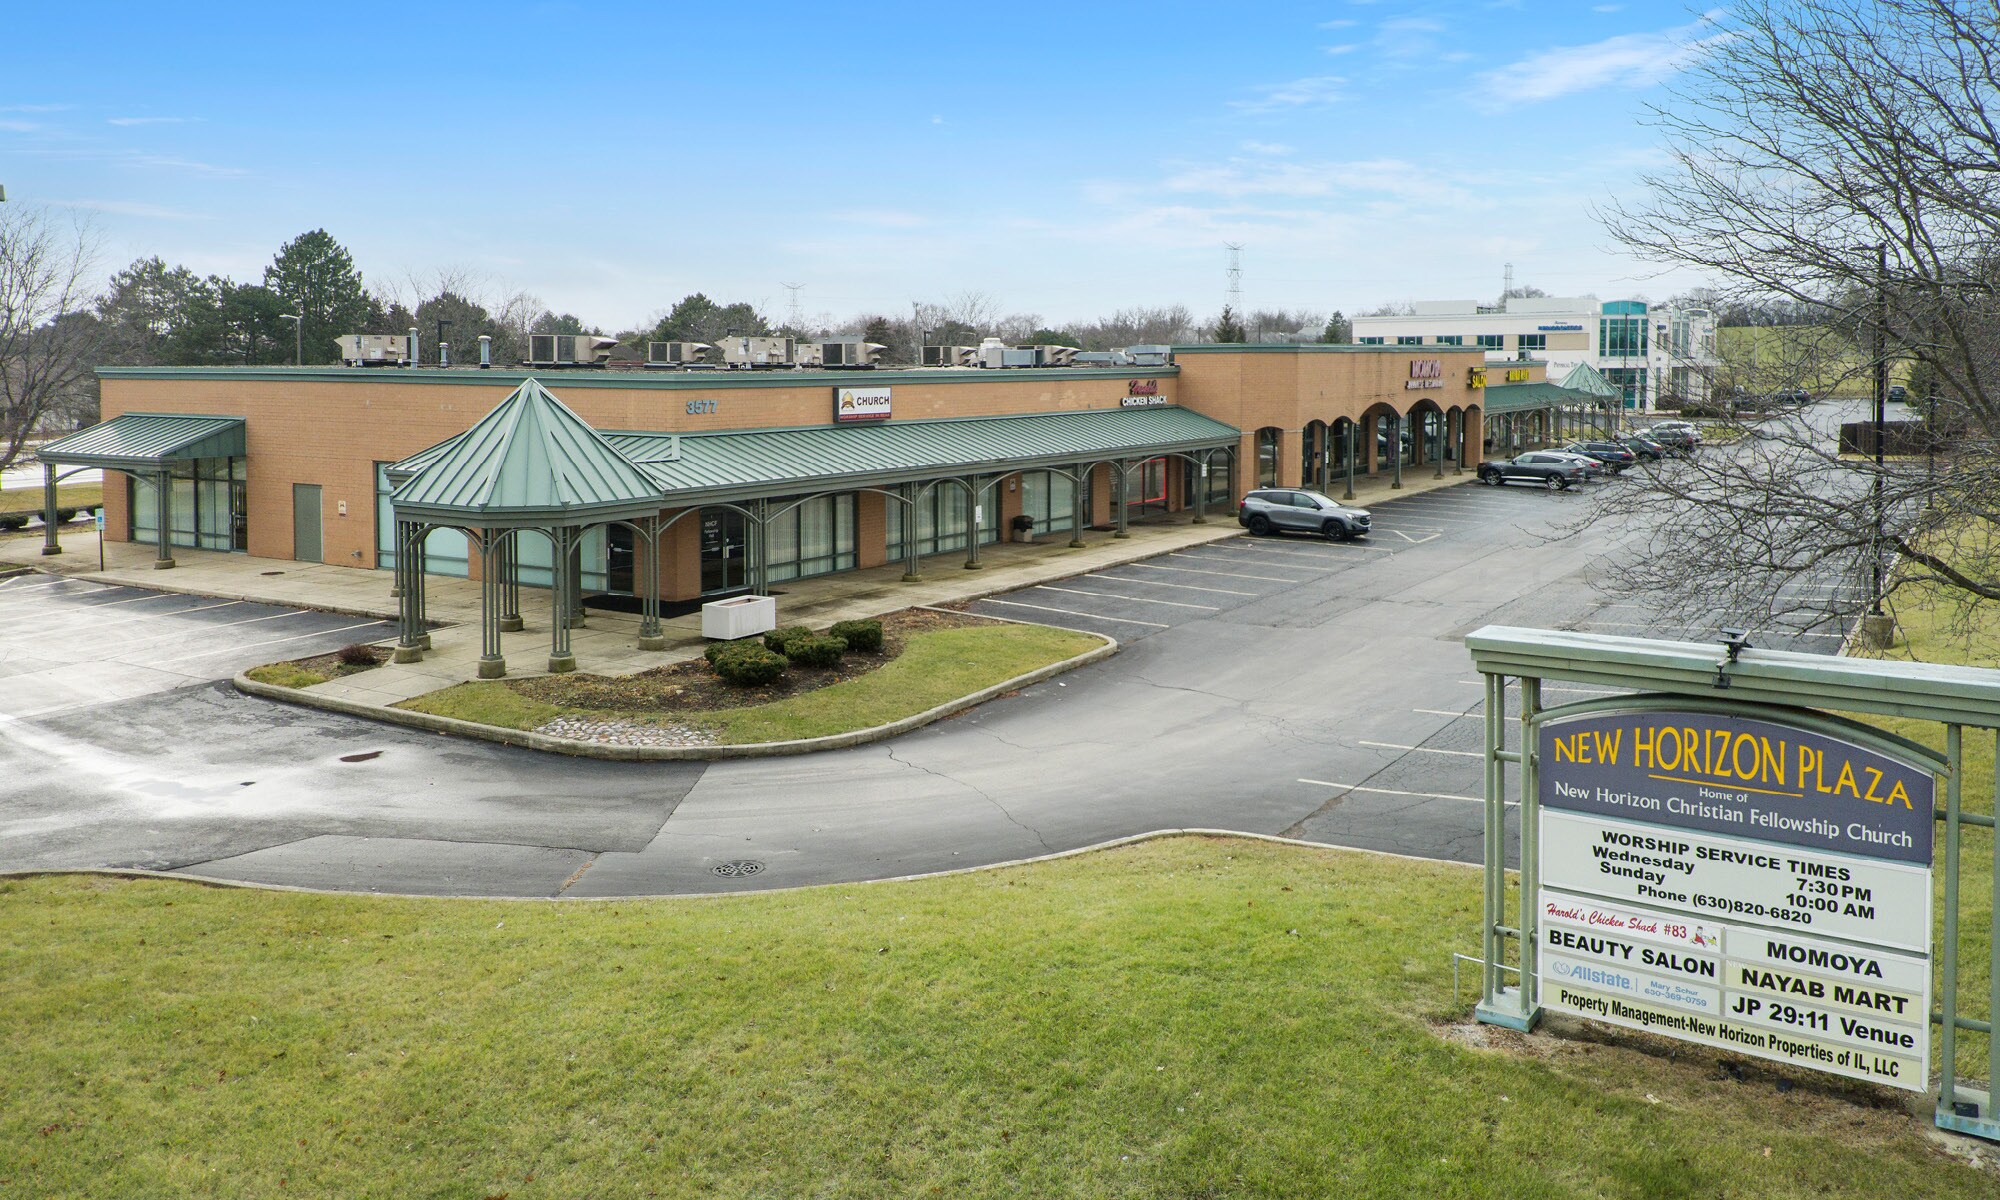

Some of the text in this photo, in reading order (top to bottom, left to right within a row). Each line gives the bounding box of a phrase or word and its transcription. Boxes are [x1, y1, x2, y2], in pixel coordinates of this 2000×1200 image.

[686, 399, 718, 415] 3577
[857, 396, 890, 406] CHURCH
[1122, 395, 1167, 406] CHICKEN SHACK
[1554, 726, 1913, 810] NEW HORIZON PLAZA
[1555, 781, 1913, 848] New Horizon Christian Fellowship Church
[1699, 787, 1749, 803] Home of
[1592, 845, 1872, 902] Wednesday 7:30 PM
[1602, 831, 1851, 881] WORSHIP SERVICE TIMES
[1600, 861, 1875, 919] Sunday 10:00 AM
[1637, 884, 1812, 924] Phone (630)820-6820
[1546, 903, 1687, 939] Harold's Chicken Shack #83
[1549, 929, 1715, 977] BEAUTY SALON
[1767, 941, 1883, 979] MOMOYA
[1570, 965, 1630, 990] Allstate
[1644, 988, 1707, 1007] 630-369-0759
[1650, 980, 1699, 996] Mary Schur
[1741, 968, 1909, 1014] NAYAB MART
[1561, 989, 1608, 1016] Property
[1719, 1023, 1765, 1047] Horizon
[1769, 1034, 1834, 1063] Properties
[1837, 1051, 1851, 1066] of
[1854, 1053, 1870, 1075] IL,
[1874, 1057, 1899, 1078] LLC
[1732, 996, 1914, 1048] JP 29:11 Venue
